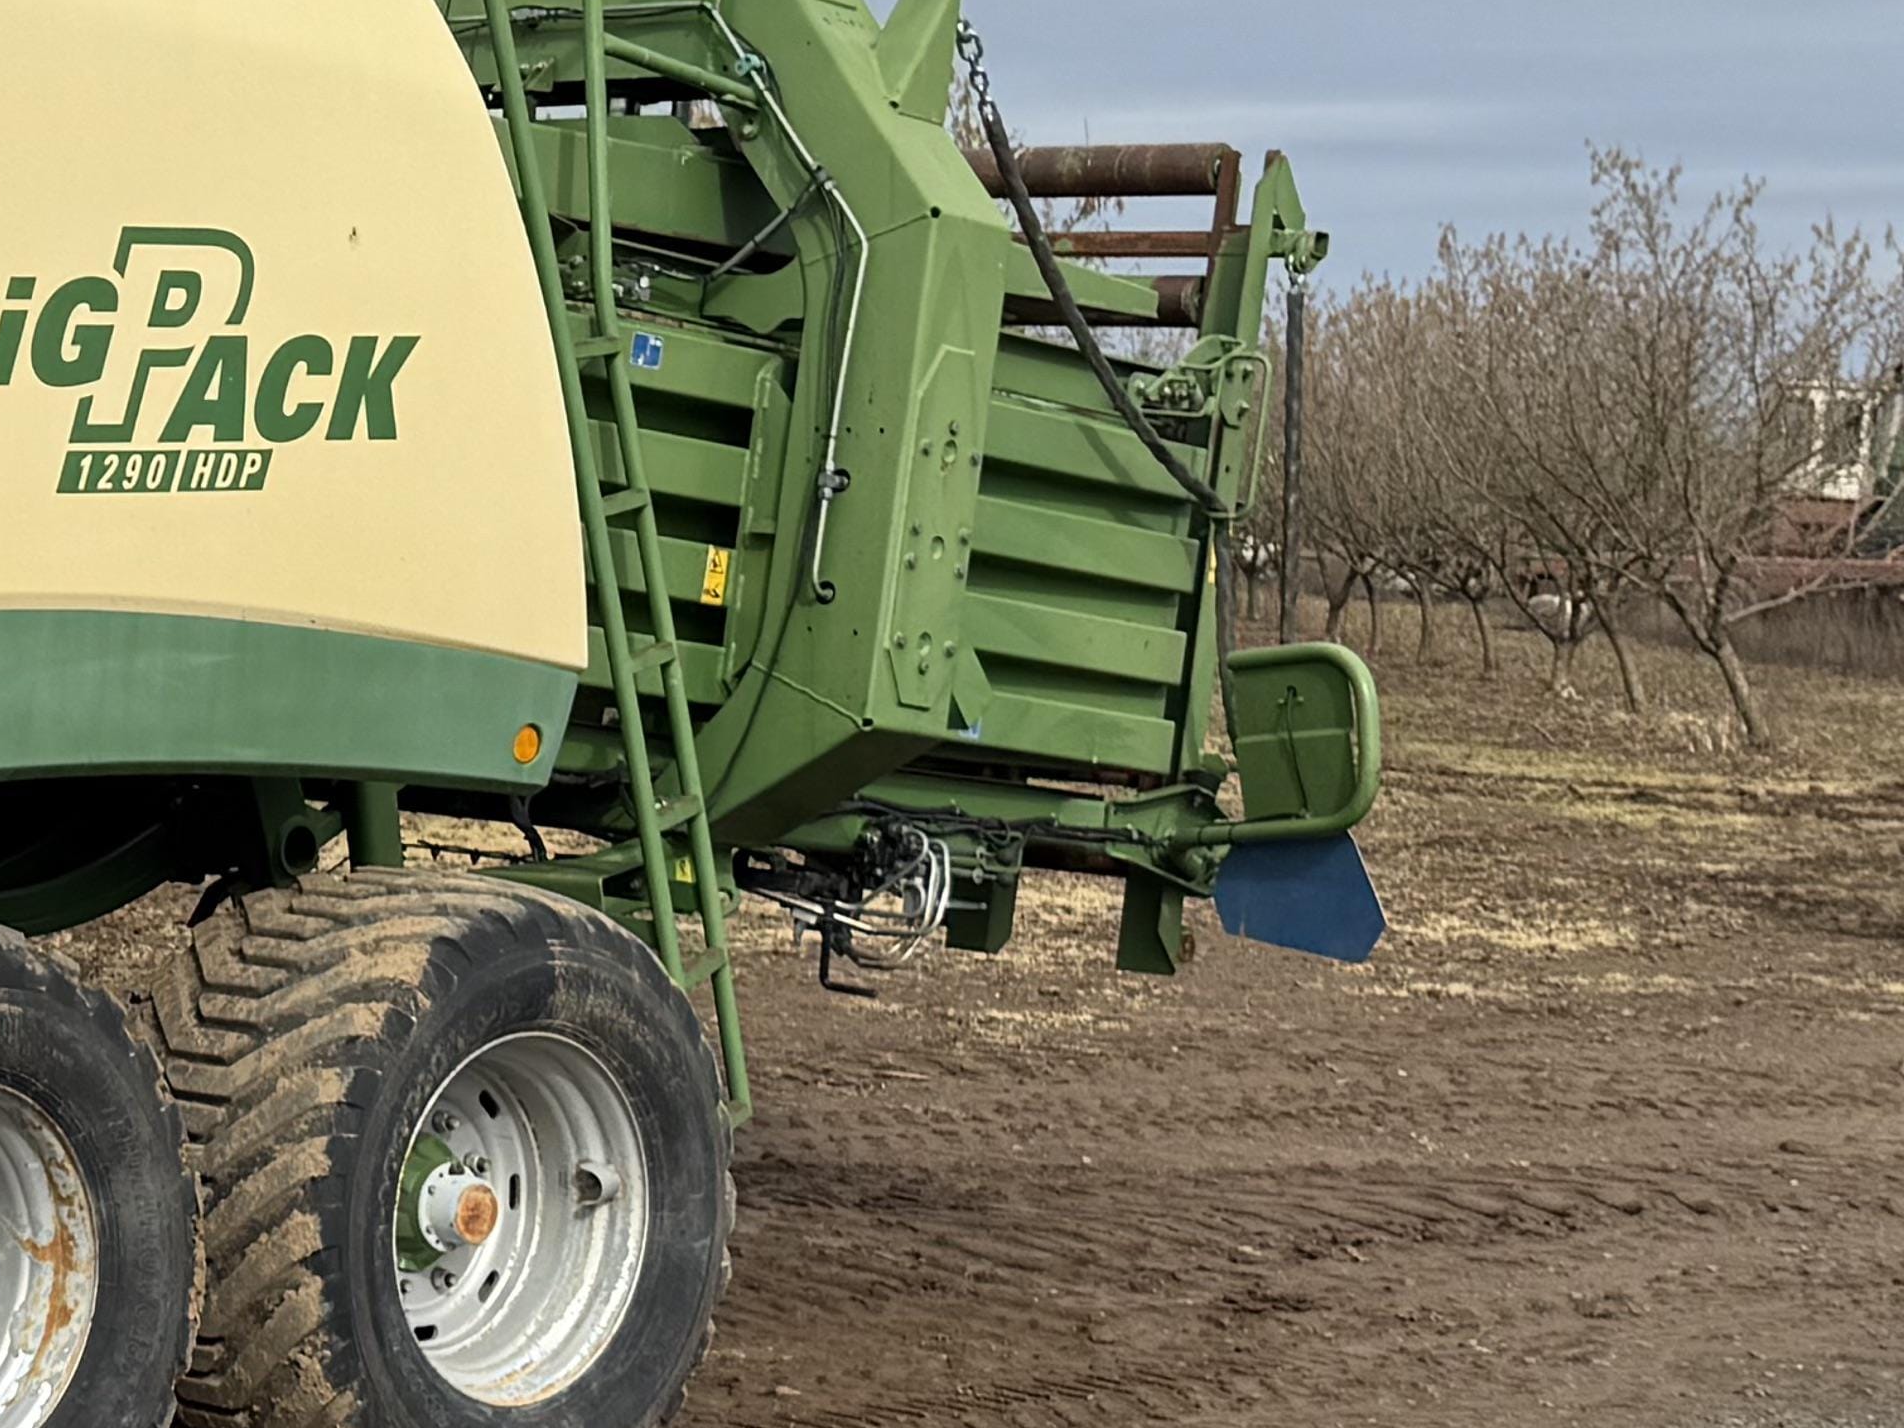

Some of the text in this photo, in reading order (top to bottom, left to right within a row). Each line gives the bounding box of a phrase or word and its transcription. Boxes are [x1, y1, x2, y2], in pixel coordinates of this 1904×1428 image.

[69, 226, 421, 443] PACK
[77, 451, 264, 490] 1290 HDP
